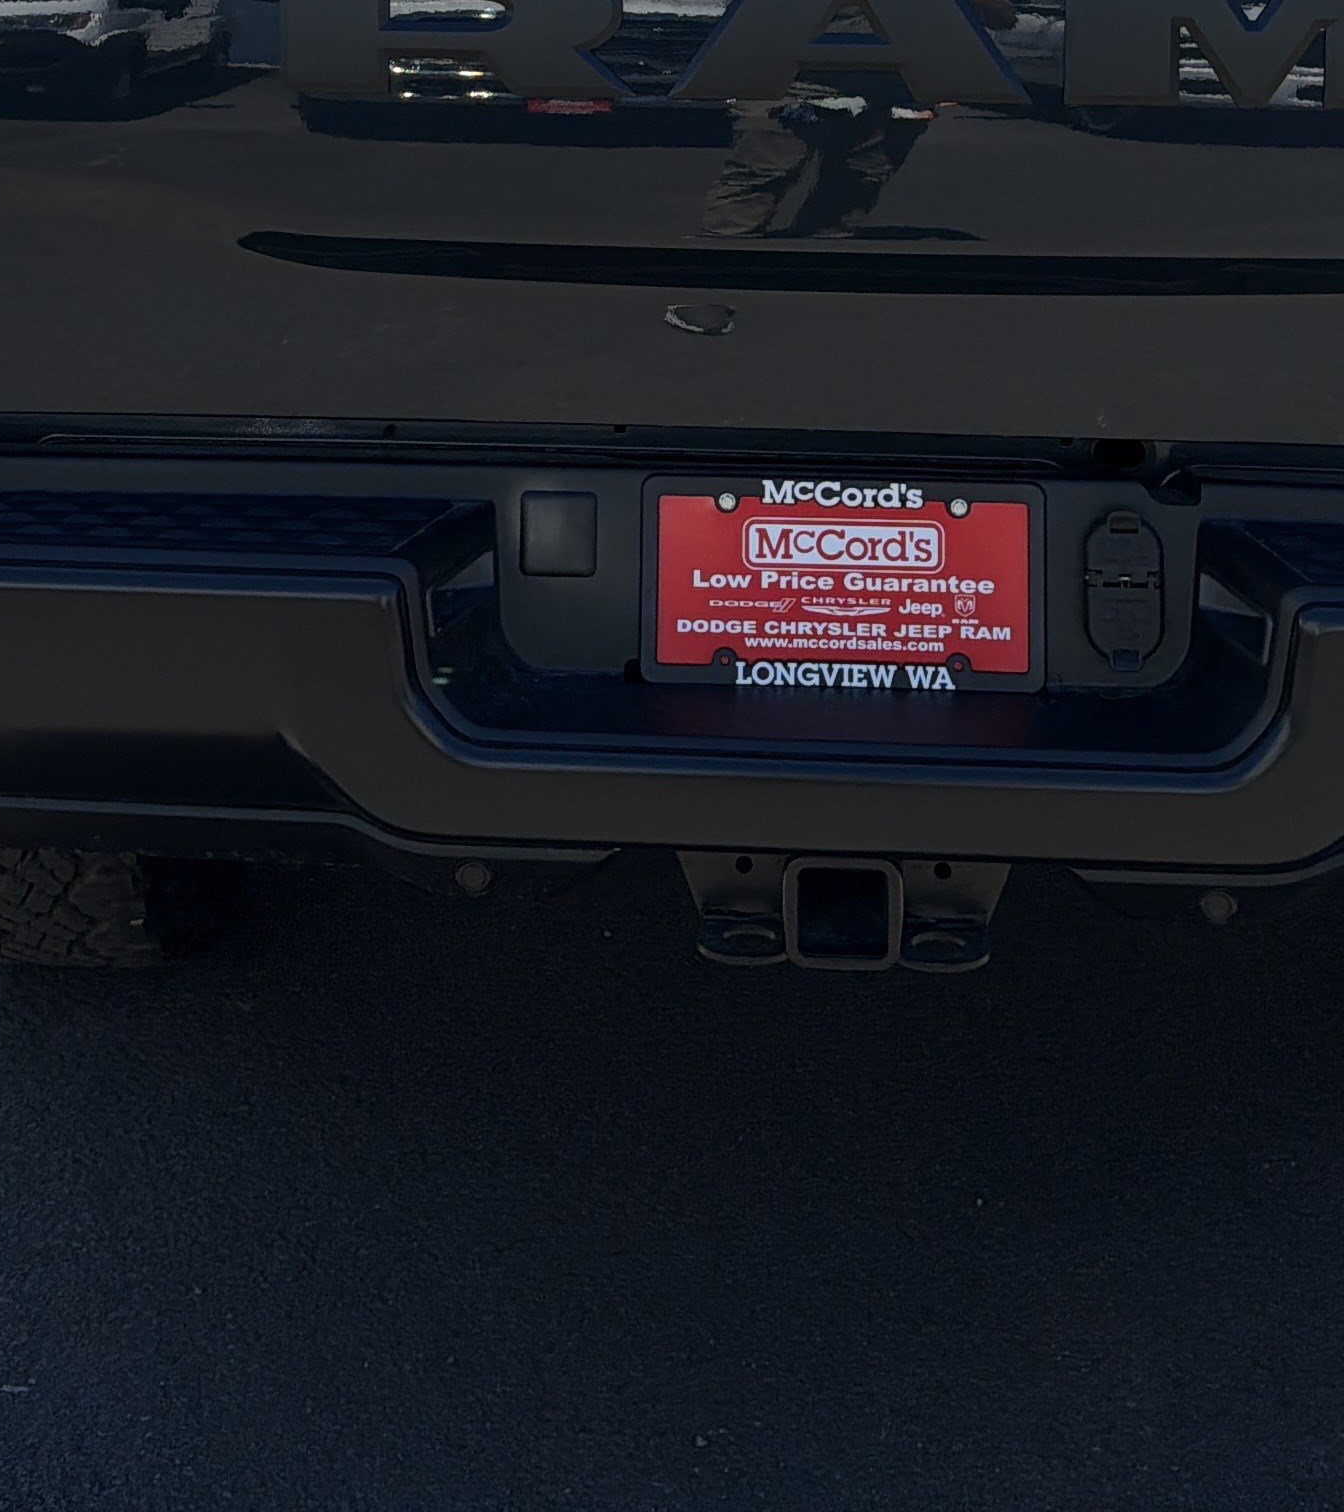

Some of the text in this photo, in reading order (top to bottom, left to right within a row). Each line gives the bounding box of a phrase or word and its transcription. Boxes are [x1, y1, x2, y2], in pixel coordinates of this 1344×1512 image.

[761, 479, 924, 510] McCord's
[754, 527, 933, 563] McCord's
[692, 570, 995, 595] Low Price Guarantee
[708, 596, 944, 618] DODGE CHRYSLER Jeep
[676, 618, 1012, 641] DODGE CHRYSLER JEEP RAM
[744, 636, 945, 653] www.mccordsales.com
[735, 661, 956, 690] LONGVIEW WA
